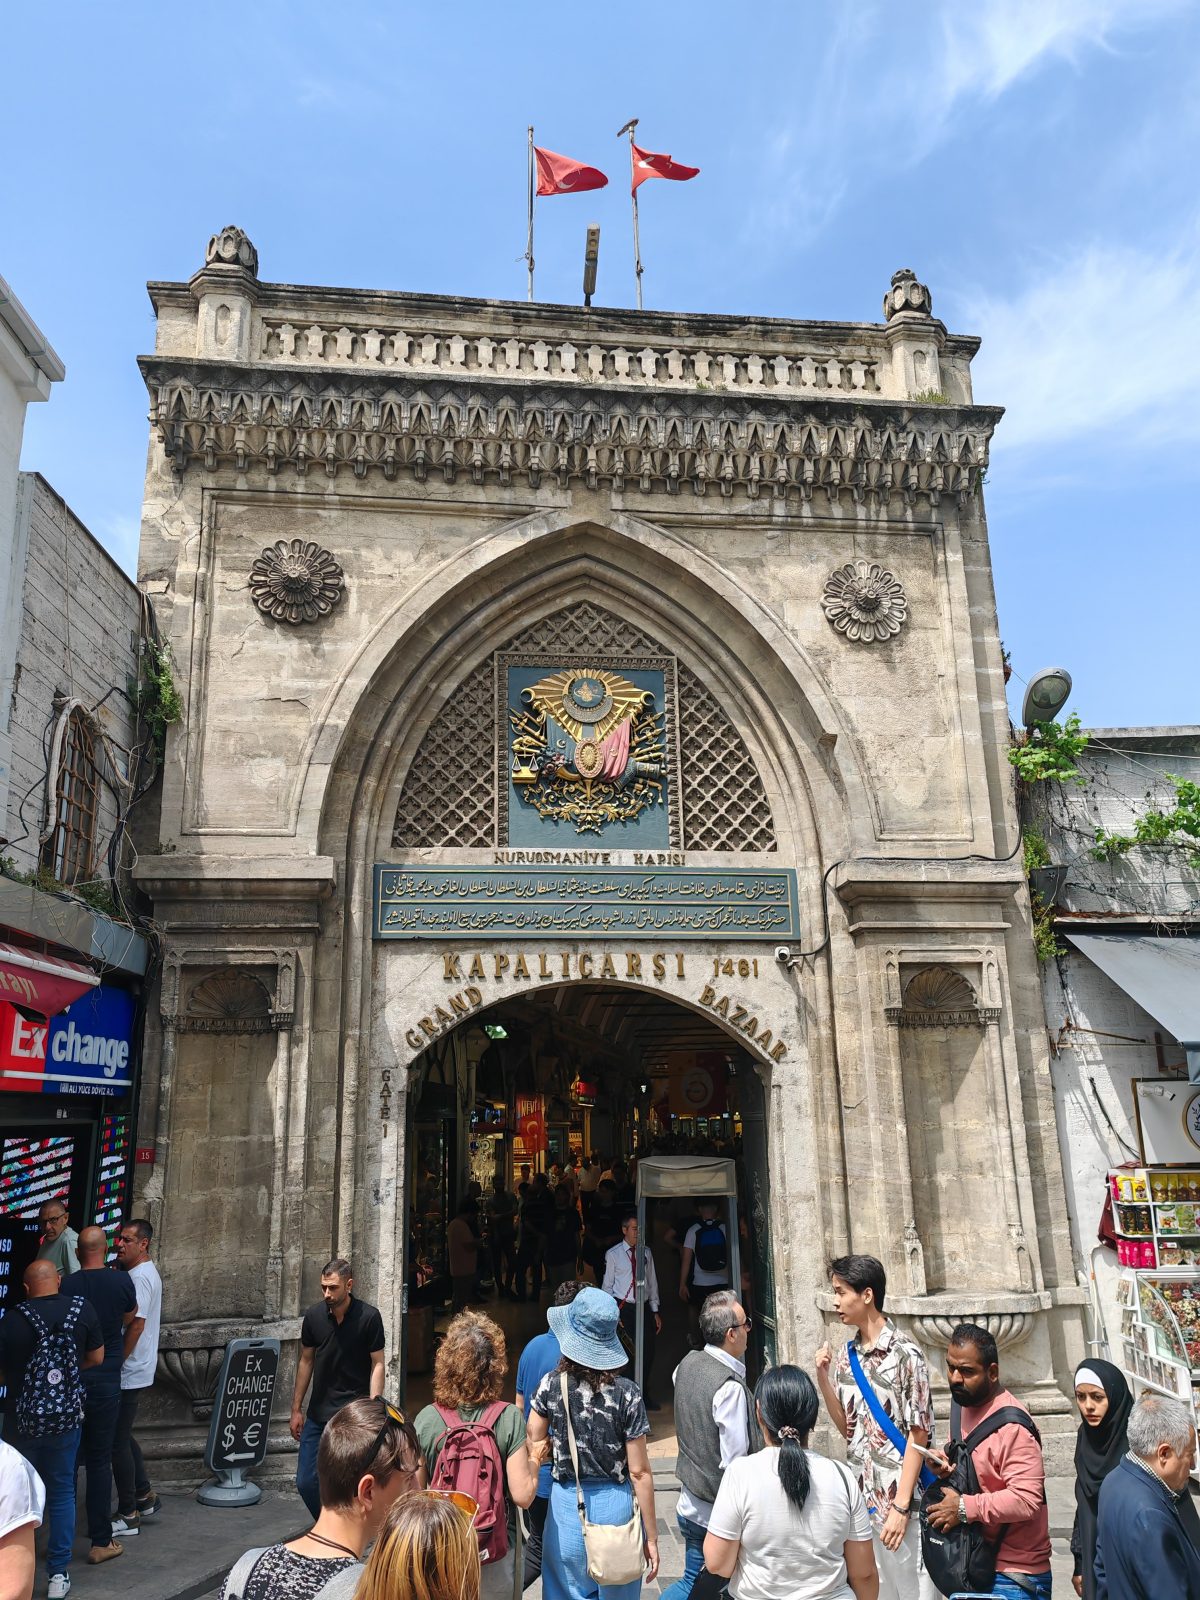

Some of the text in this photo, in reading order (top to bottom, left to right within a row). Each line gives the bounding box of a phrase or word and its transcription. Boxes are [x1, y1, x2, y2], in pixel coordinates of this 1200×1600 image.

[633, 853, 686, 866] KAPISI
[713, 957, 759, 977] 1461
[405, 984, 789, 1063] GRAND BAZAAR
[52, 1021, 129, 1077] change
[380, 1069, 392, 1120] GATE
[141, 1152, 150, 1160] 15
[0, 1239, 12, 1253] SD
[227, 1374, 274, 1395] CHANGE
[226, 1398, 268, 1419] OFFICE
